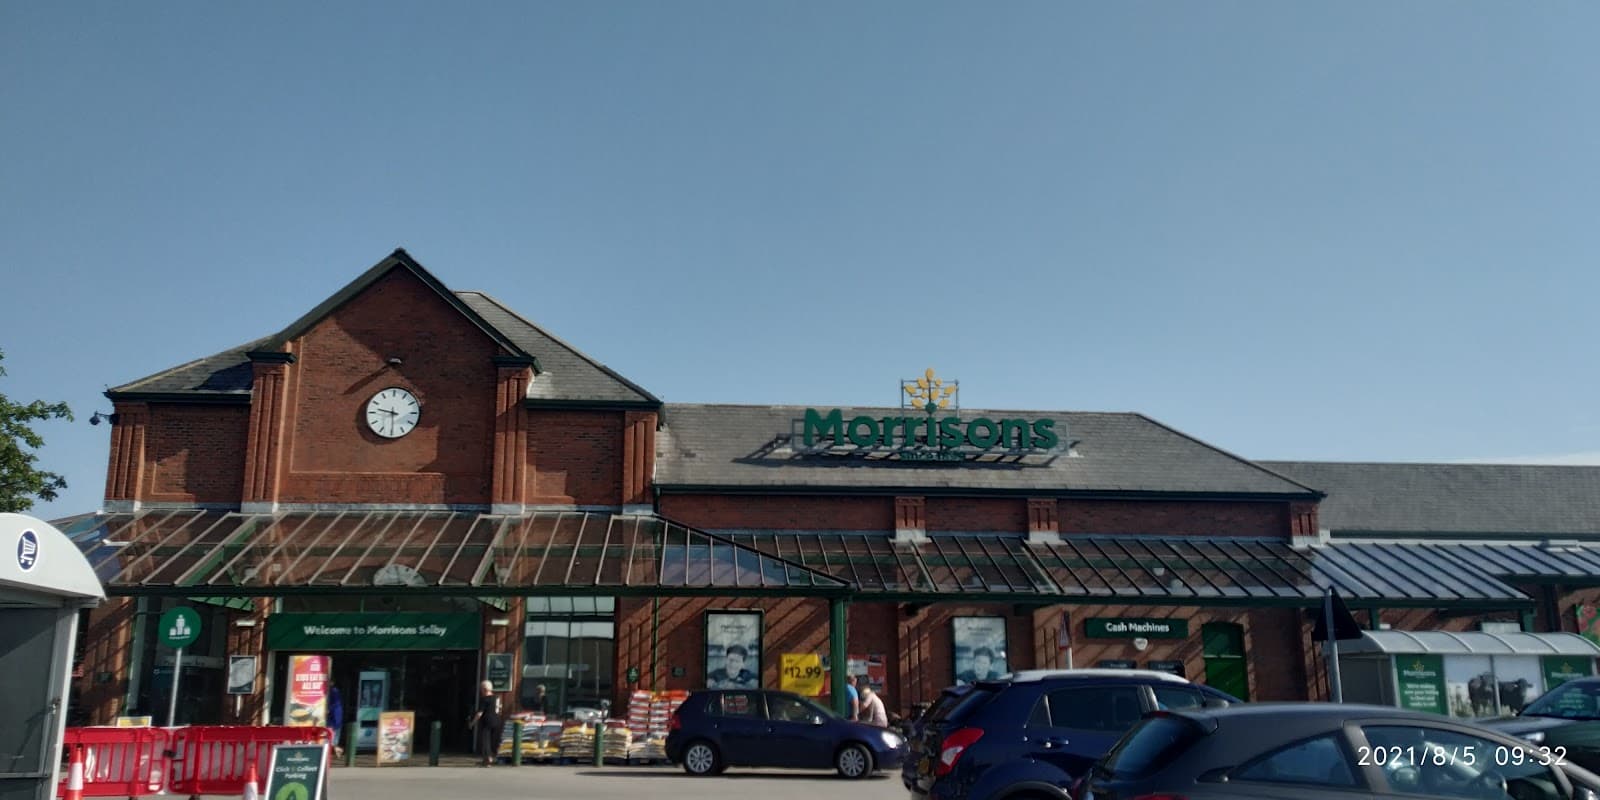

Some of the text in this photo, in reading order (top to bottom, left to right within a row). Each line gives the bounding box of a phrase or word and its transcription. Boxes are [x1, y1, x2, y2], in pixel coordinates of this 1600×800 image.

[803, 402, 1059, 449] Morrisons
[304, 624, 448, 637] Welcome to Morrisons Selby
[1105, 622, 1170, 632] Cash Machines
